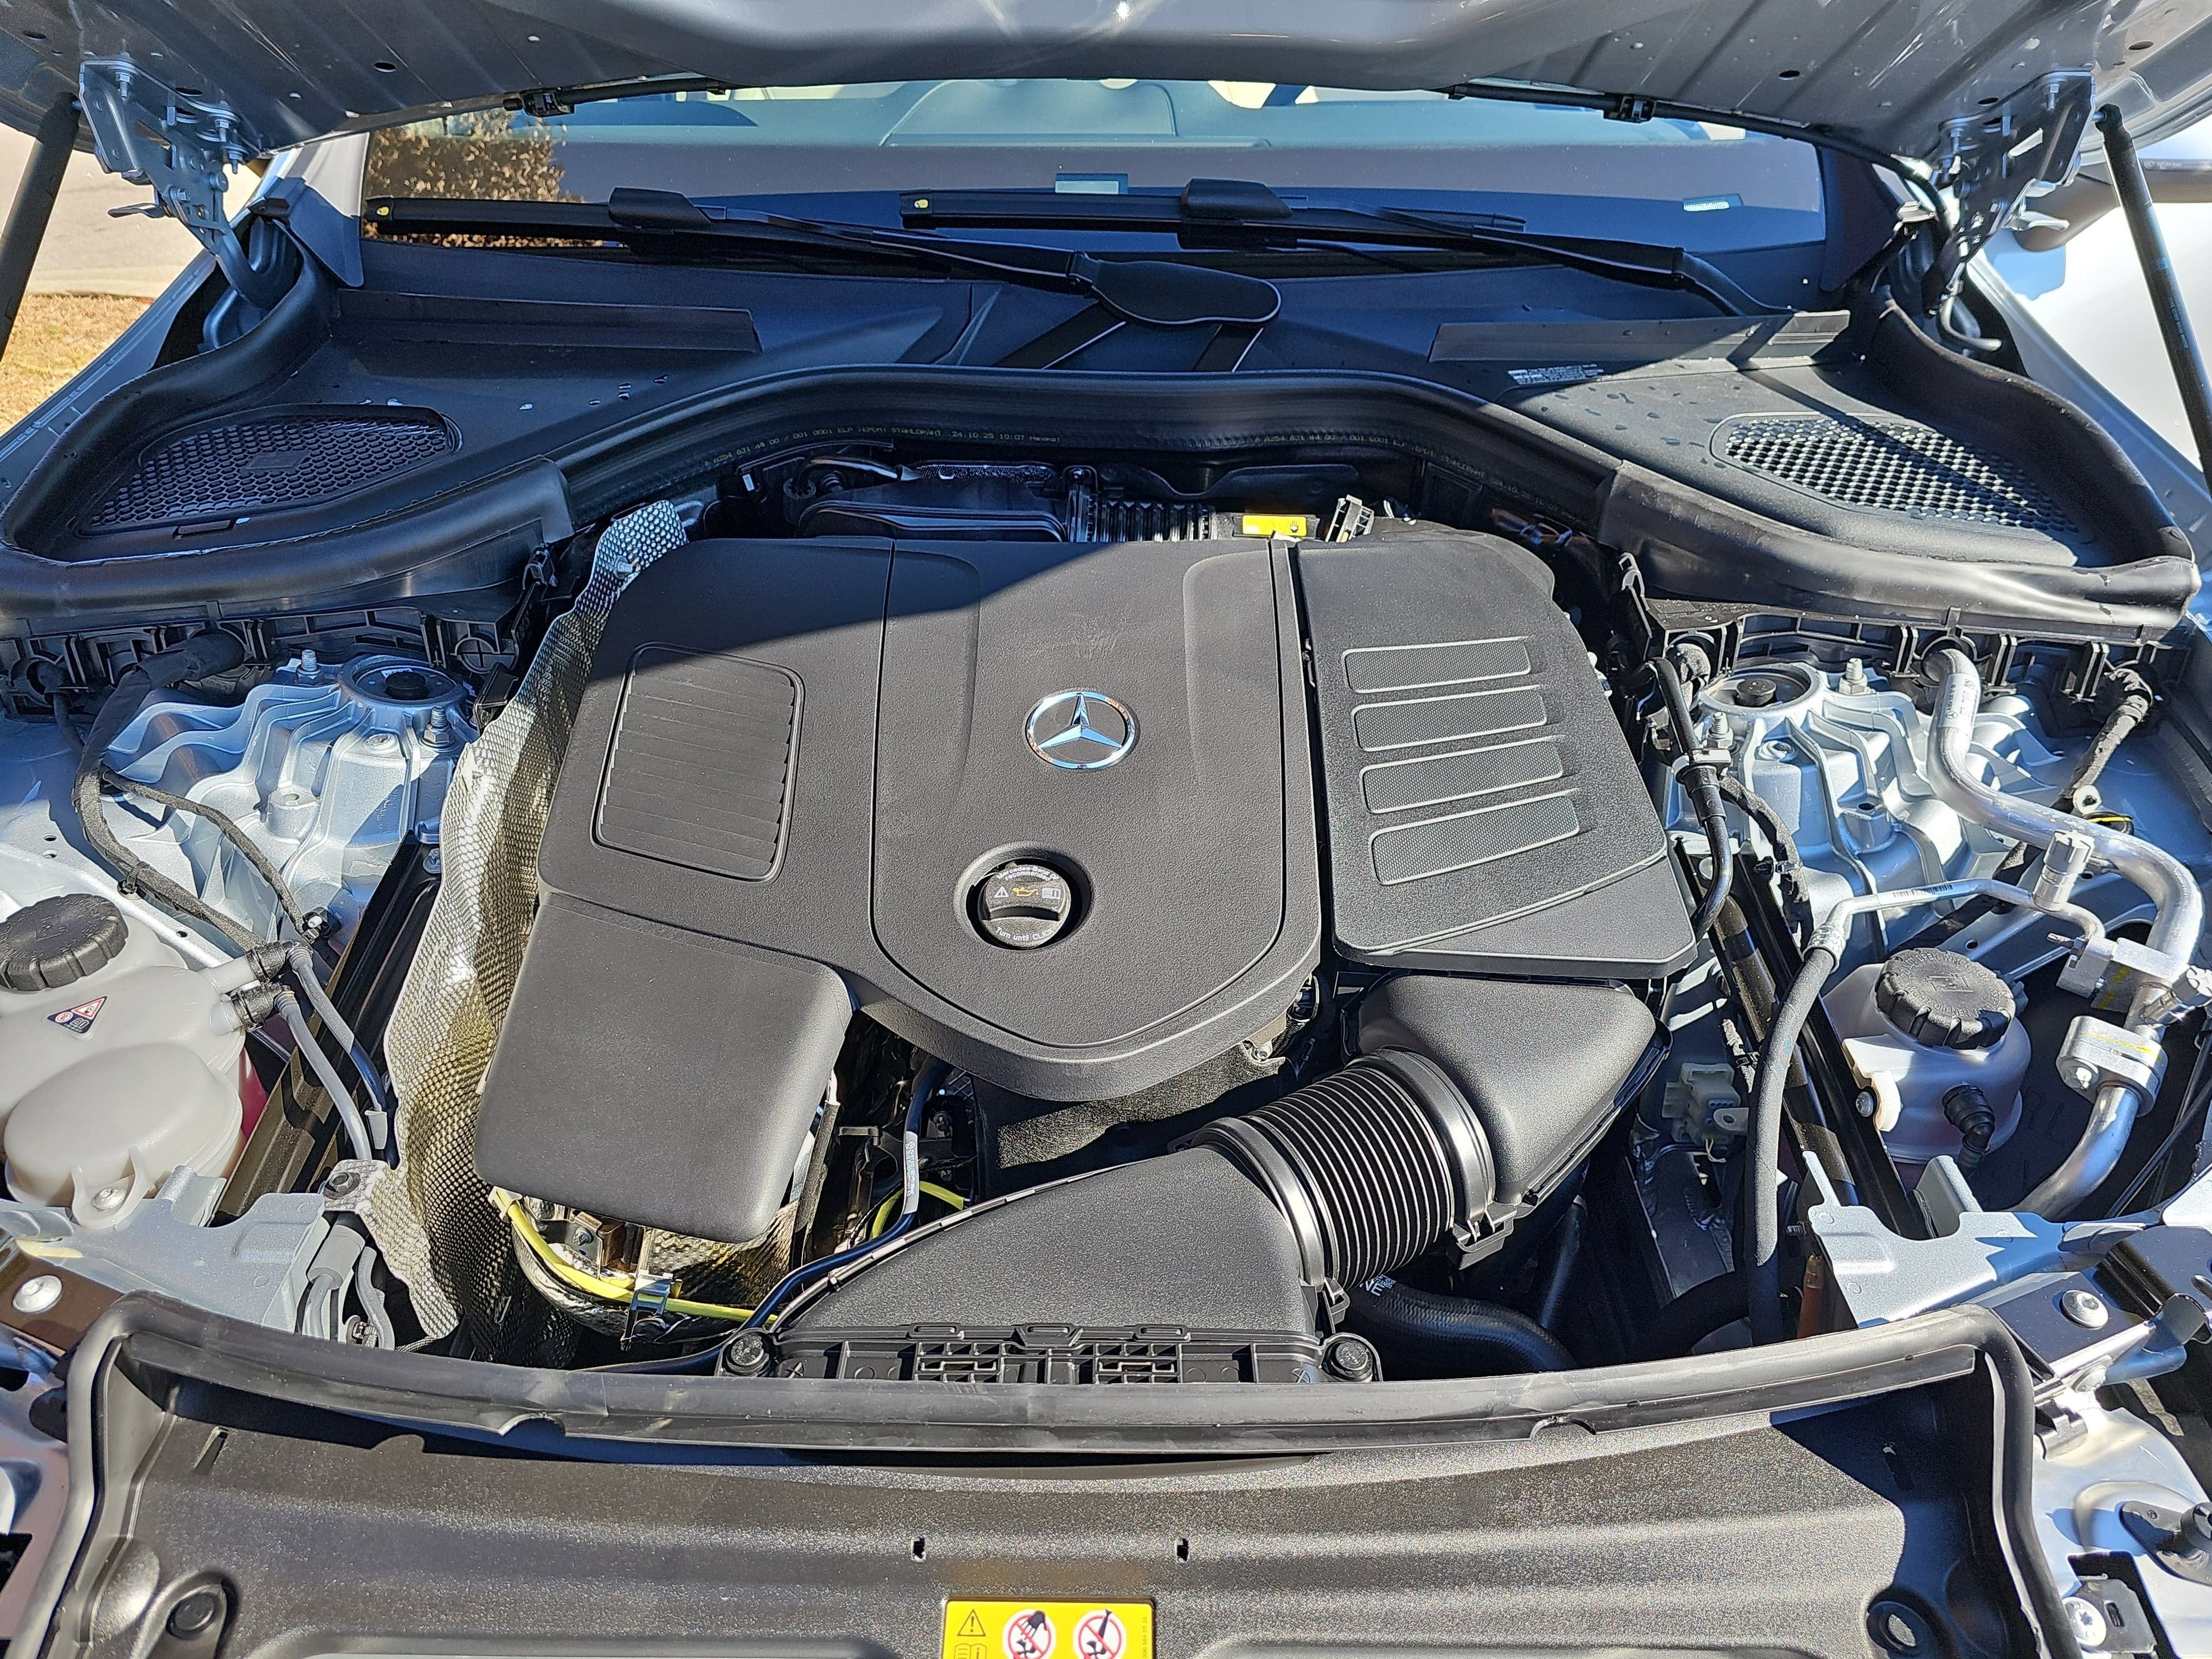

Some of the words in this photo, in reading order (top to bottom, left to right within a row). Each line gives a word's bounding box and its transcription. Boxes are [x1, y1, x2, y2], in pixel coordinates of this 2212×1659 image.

[1005, 870, 1051, 881] recommended
[995, 926, 1012, 939] Turn
[1032, 927, 1054, 940] CLICK
